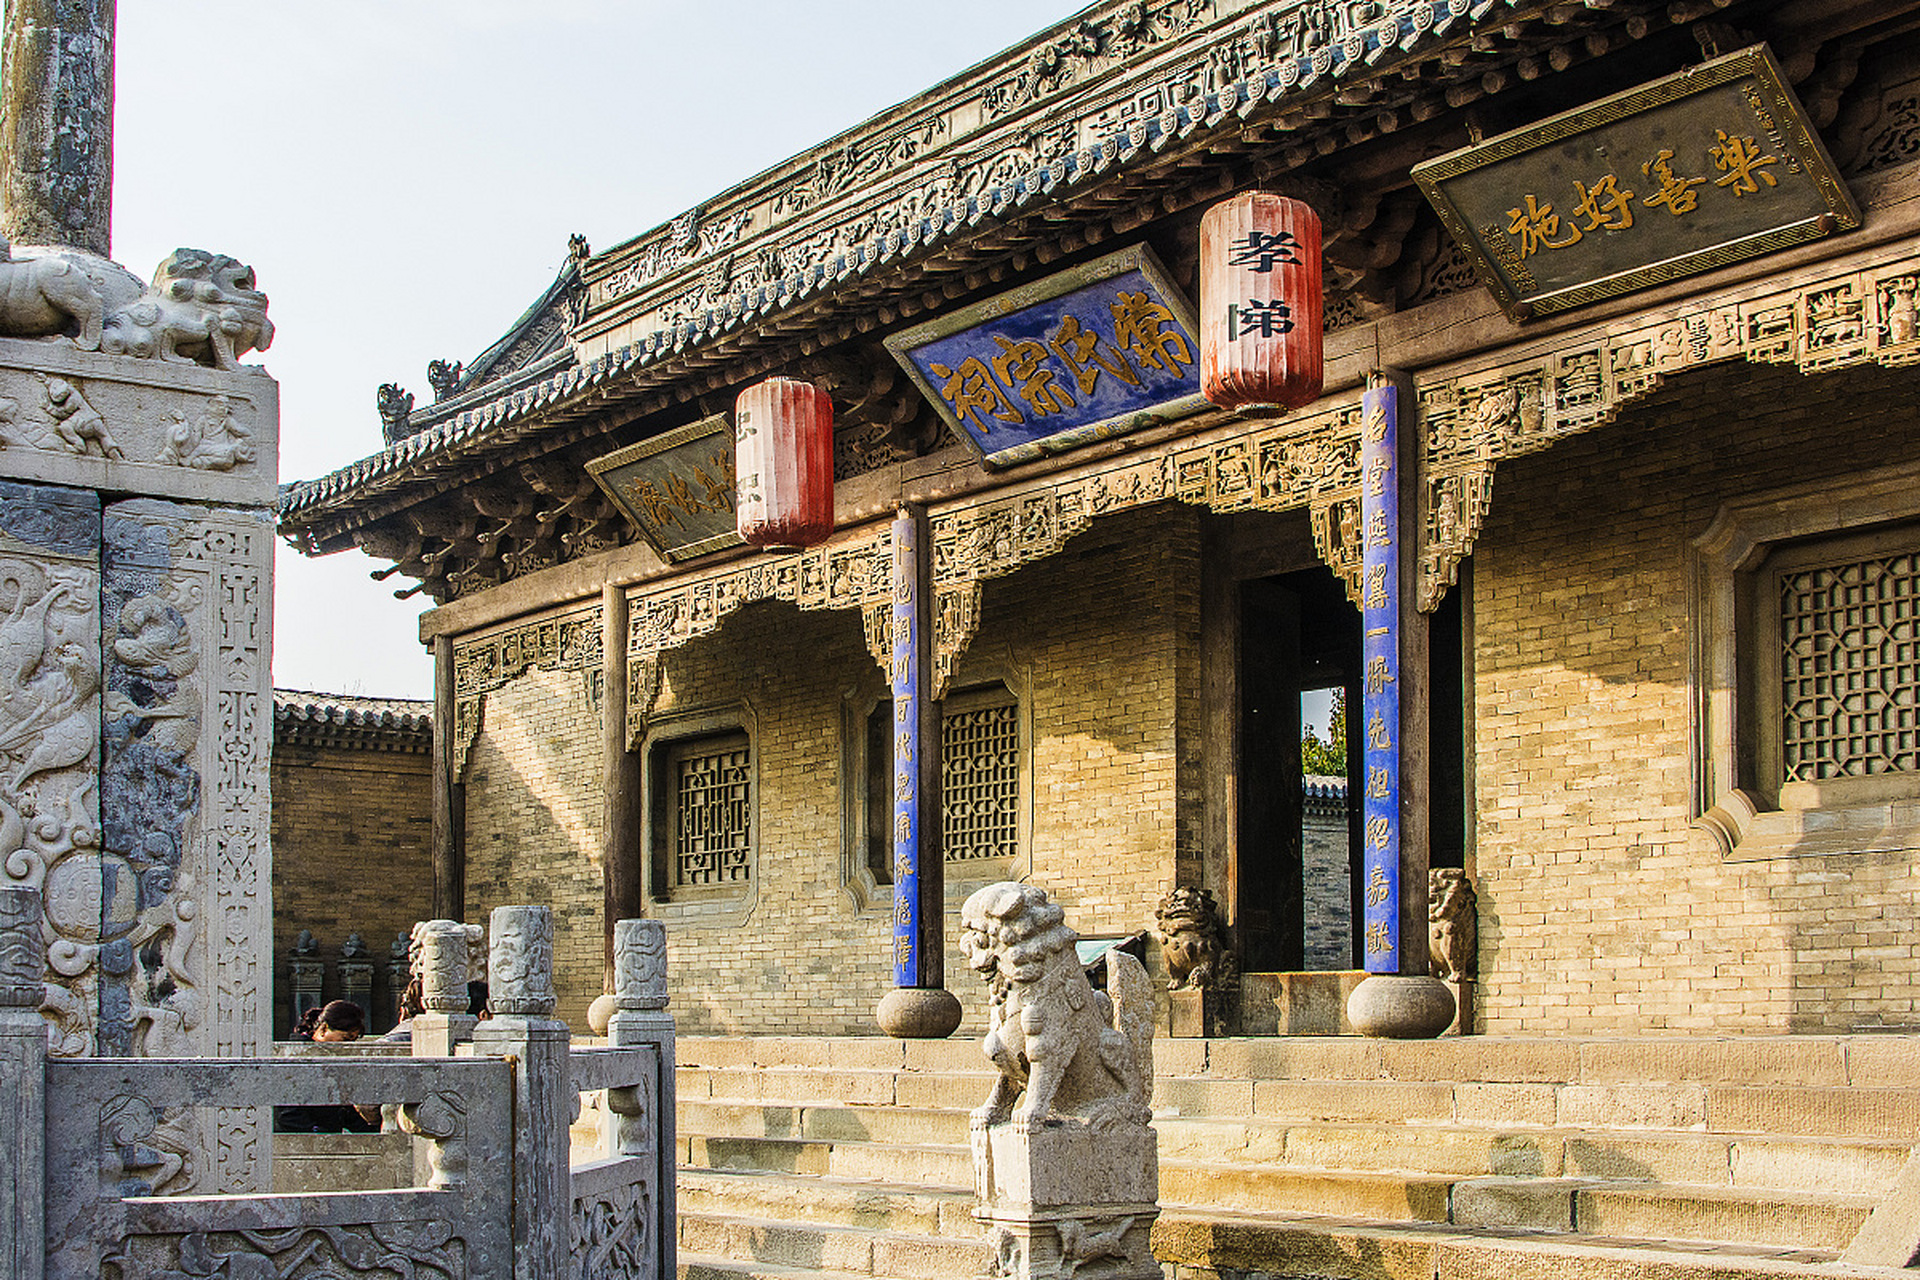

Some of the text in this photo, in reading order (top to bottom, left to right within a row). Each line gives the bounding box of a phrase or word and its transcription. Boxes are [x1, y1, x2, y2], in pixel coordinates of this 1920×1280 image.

[1228, 231, 1303, 342] 孝悌
[930, 290, 1194, 434] 常氏宗祠
